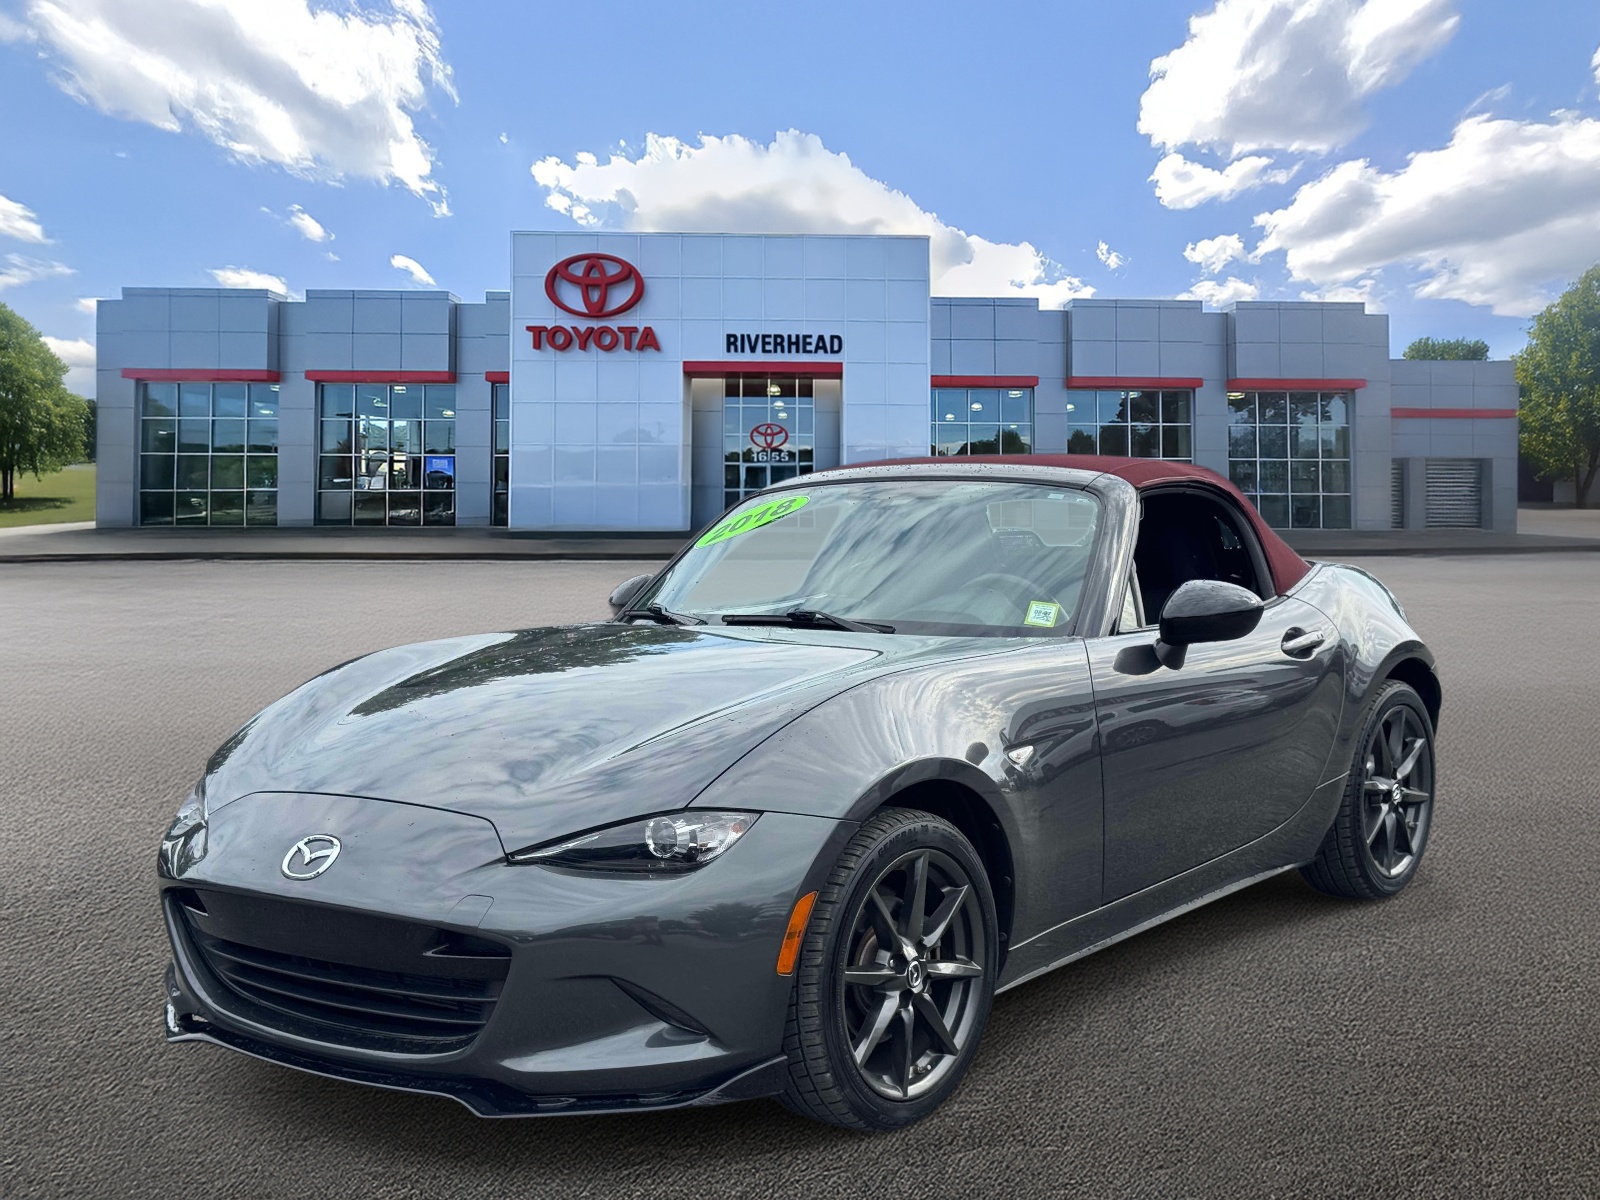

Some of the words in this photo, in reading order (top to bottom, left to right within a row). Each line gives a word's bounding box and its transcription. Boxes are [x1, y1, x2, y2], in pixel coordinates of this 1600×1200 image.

[525, 325, 661, 351] TOYOTA
[725, 333, 843, 354] RIVERHEAD
[751, 451, 789, 462] 1655
[704, 498, 797, 545] 2018
[877, 826, 919, 858] GENERAL
